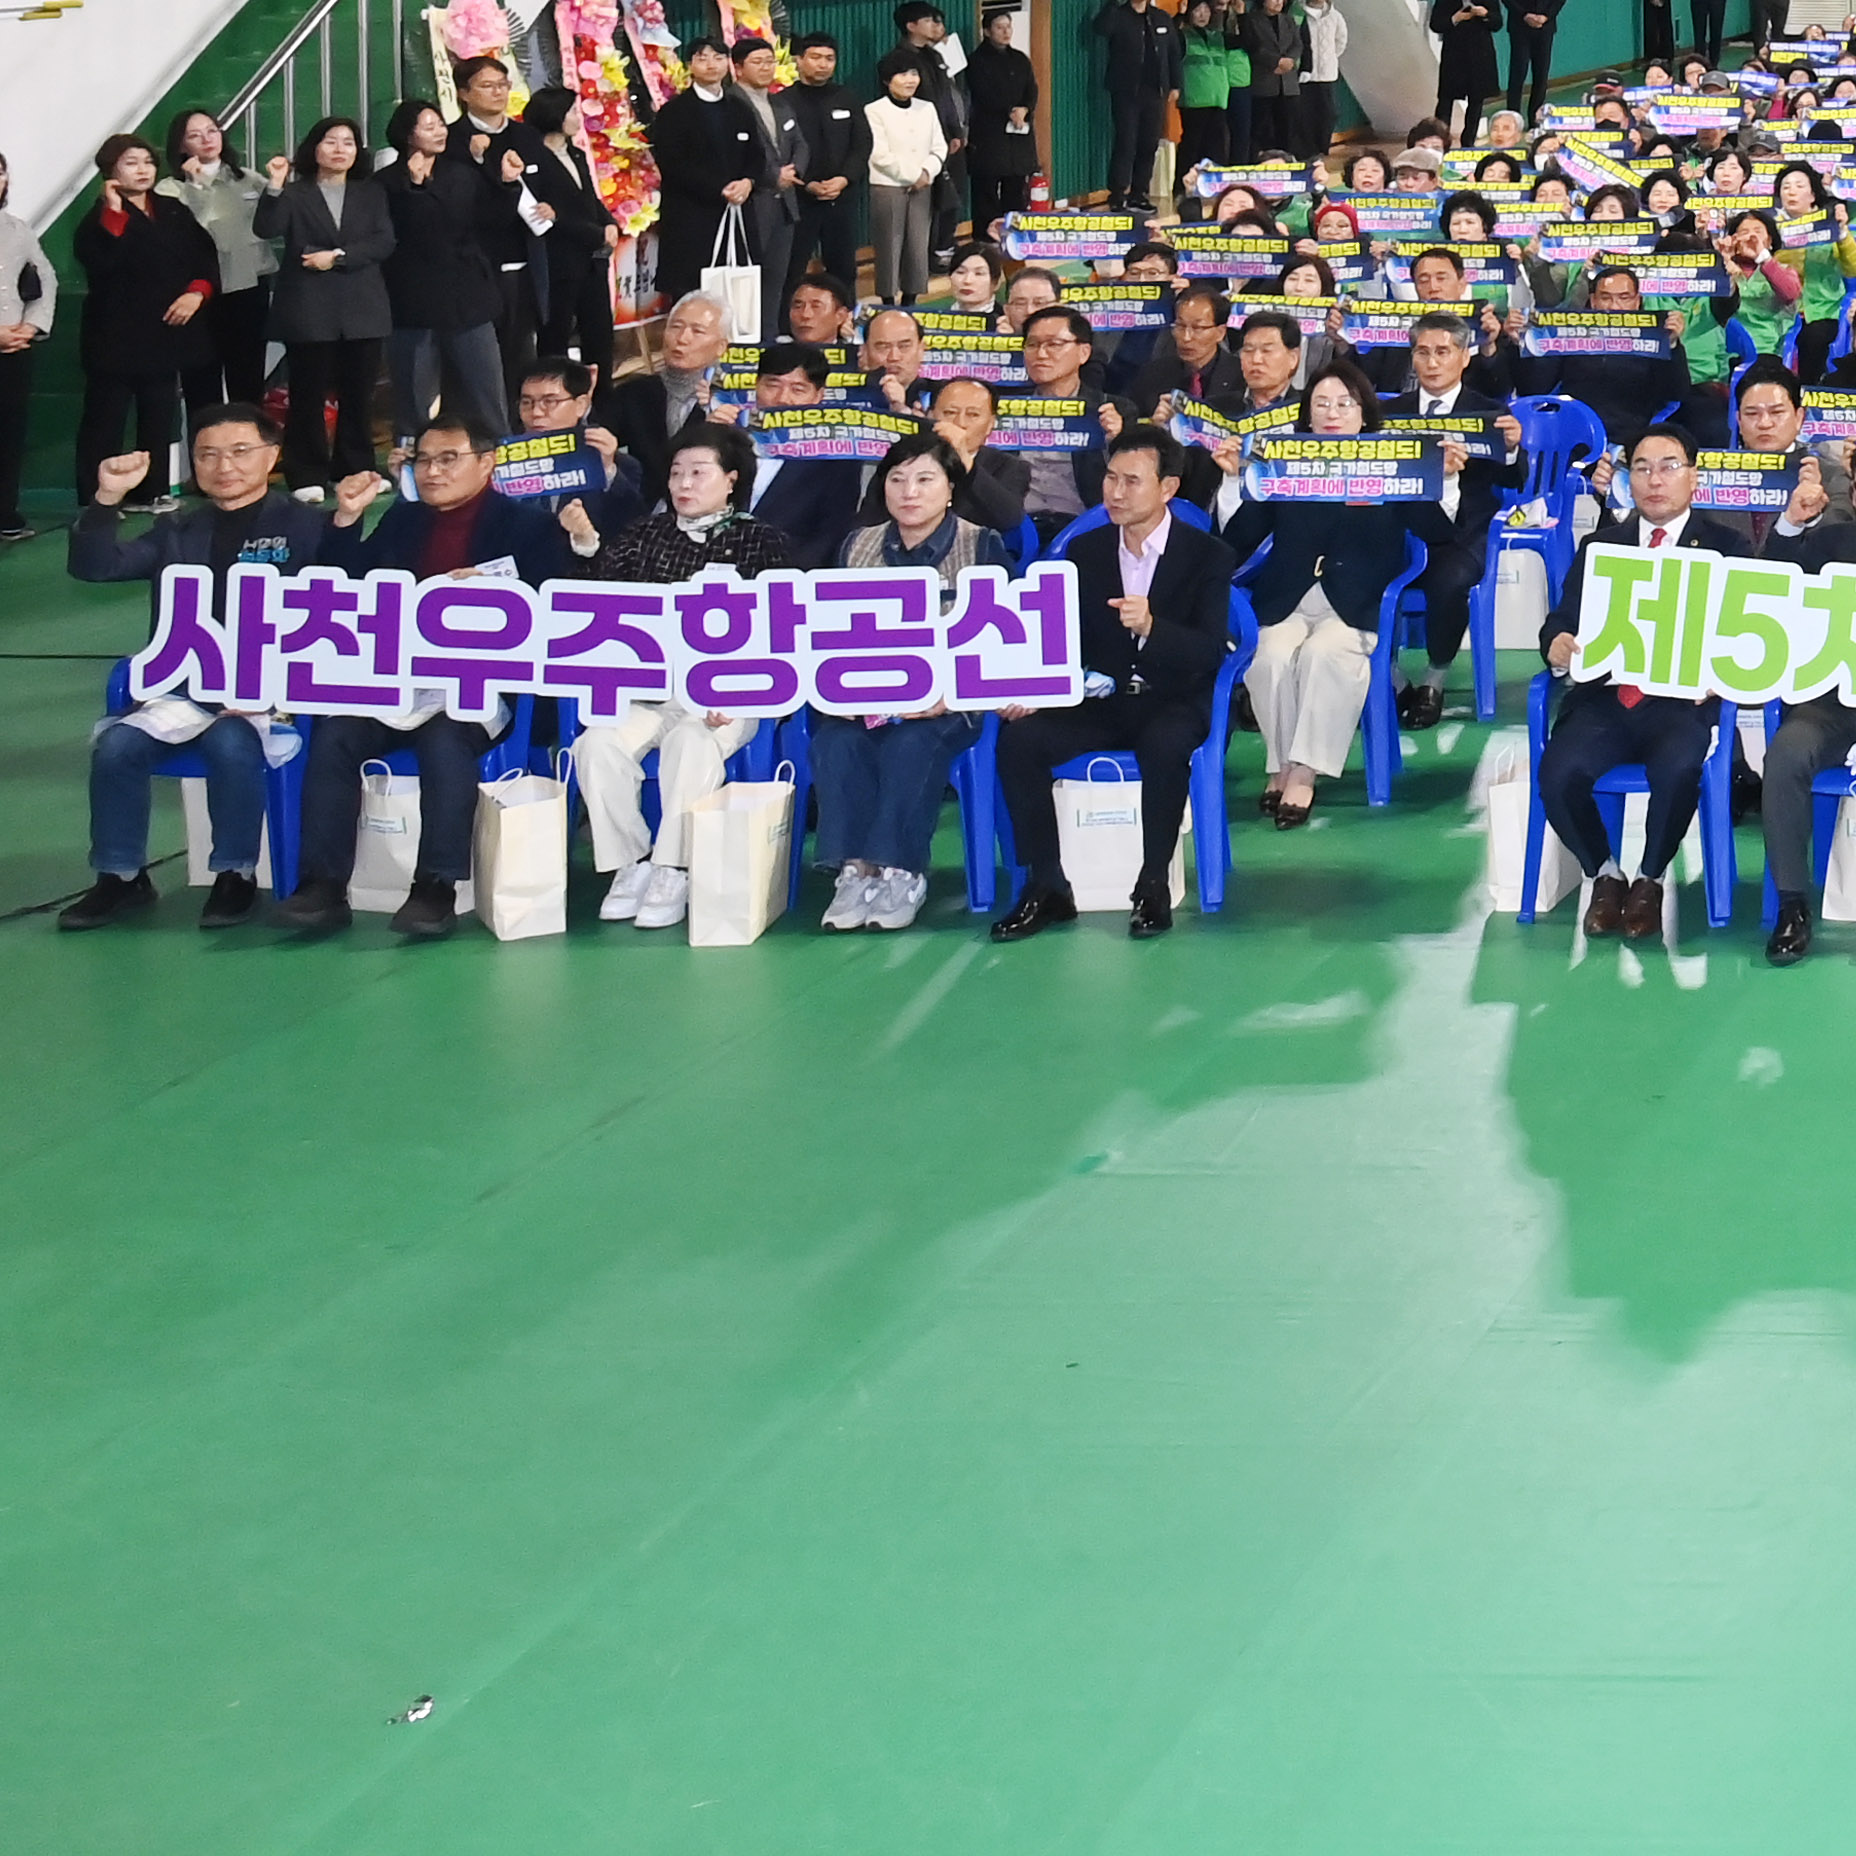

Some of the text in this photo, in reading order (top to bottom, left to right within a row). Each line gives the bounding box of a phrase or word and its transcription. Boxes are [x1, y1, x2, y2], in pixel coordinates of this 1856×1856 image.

[1538, 312, 1656, 327] 사천우주항공철도!
[1264, 440, 1421, 459] 사천우주항공철도!
[1287, 461, 1397, 474] 제5차 국가철도망
[506, 472, 586, 496] 반영하라!
[1260, 477, 1423, 494] 구축계획에 반영하라!
[143, 562, 1073, 716] 사천우주항공선
